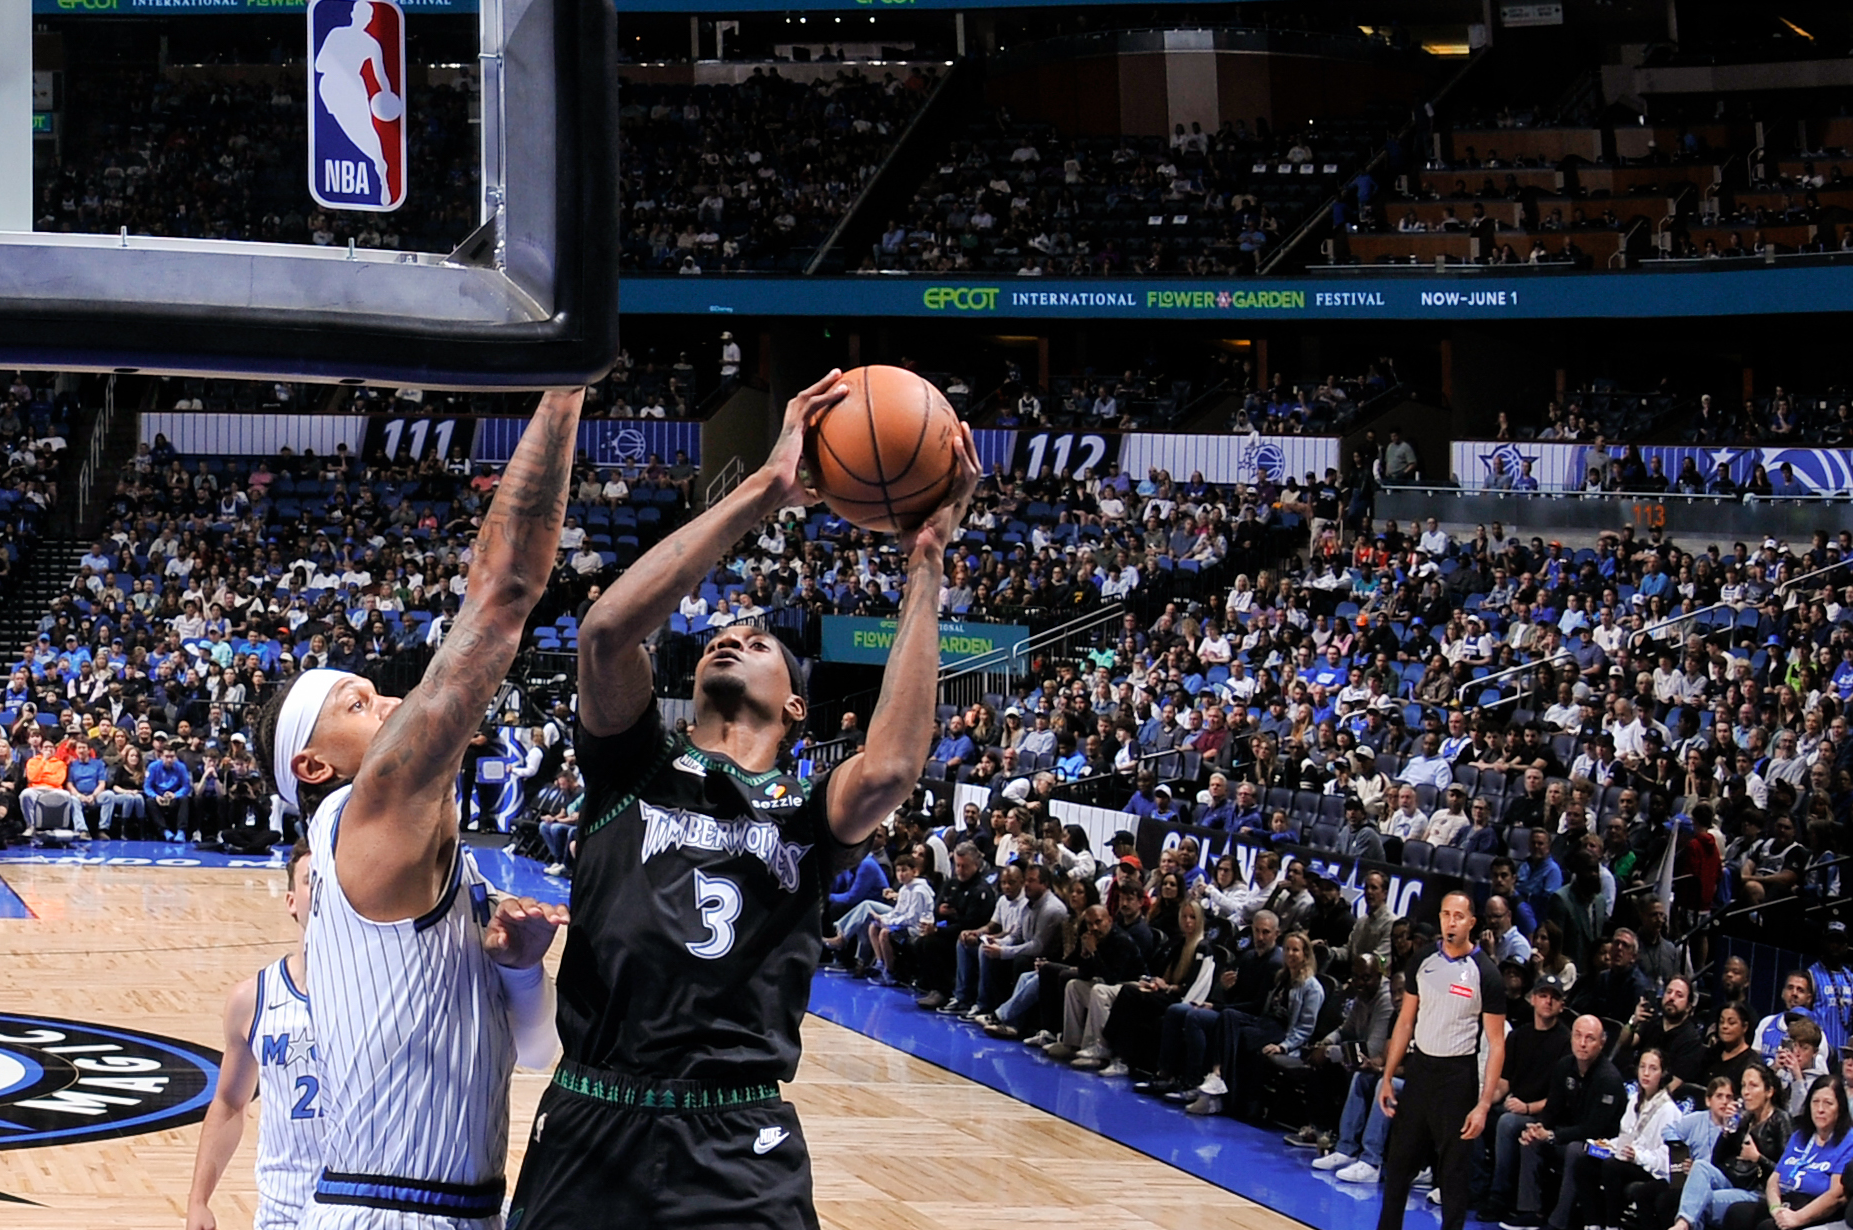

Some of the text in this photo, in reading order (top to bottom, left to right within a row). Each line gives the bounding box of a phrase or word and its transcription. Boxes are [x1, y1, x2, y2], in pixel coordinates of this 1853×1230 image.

[324, 159, 370, 195] NBA
[923, 288, 1000, 310] EPCOT
[1012, 292, 1137, 306] INTERNATIONAL
[1148, 291, 1215, 308] FLOWER
[1232, 291, 1305, 308] GARDEN
[1316, 293, 1384, 306] FESTIVAL
[384, 419, 456, 462] 111
[1028, 434, 1105, 480] 112
[1633, 505, 1665, 526] 113
[854, 631, 993, 655] FLOW ARDEN
[686, 868, 743, 959] 3
[291, 1075, 325, 1120] 2
